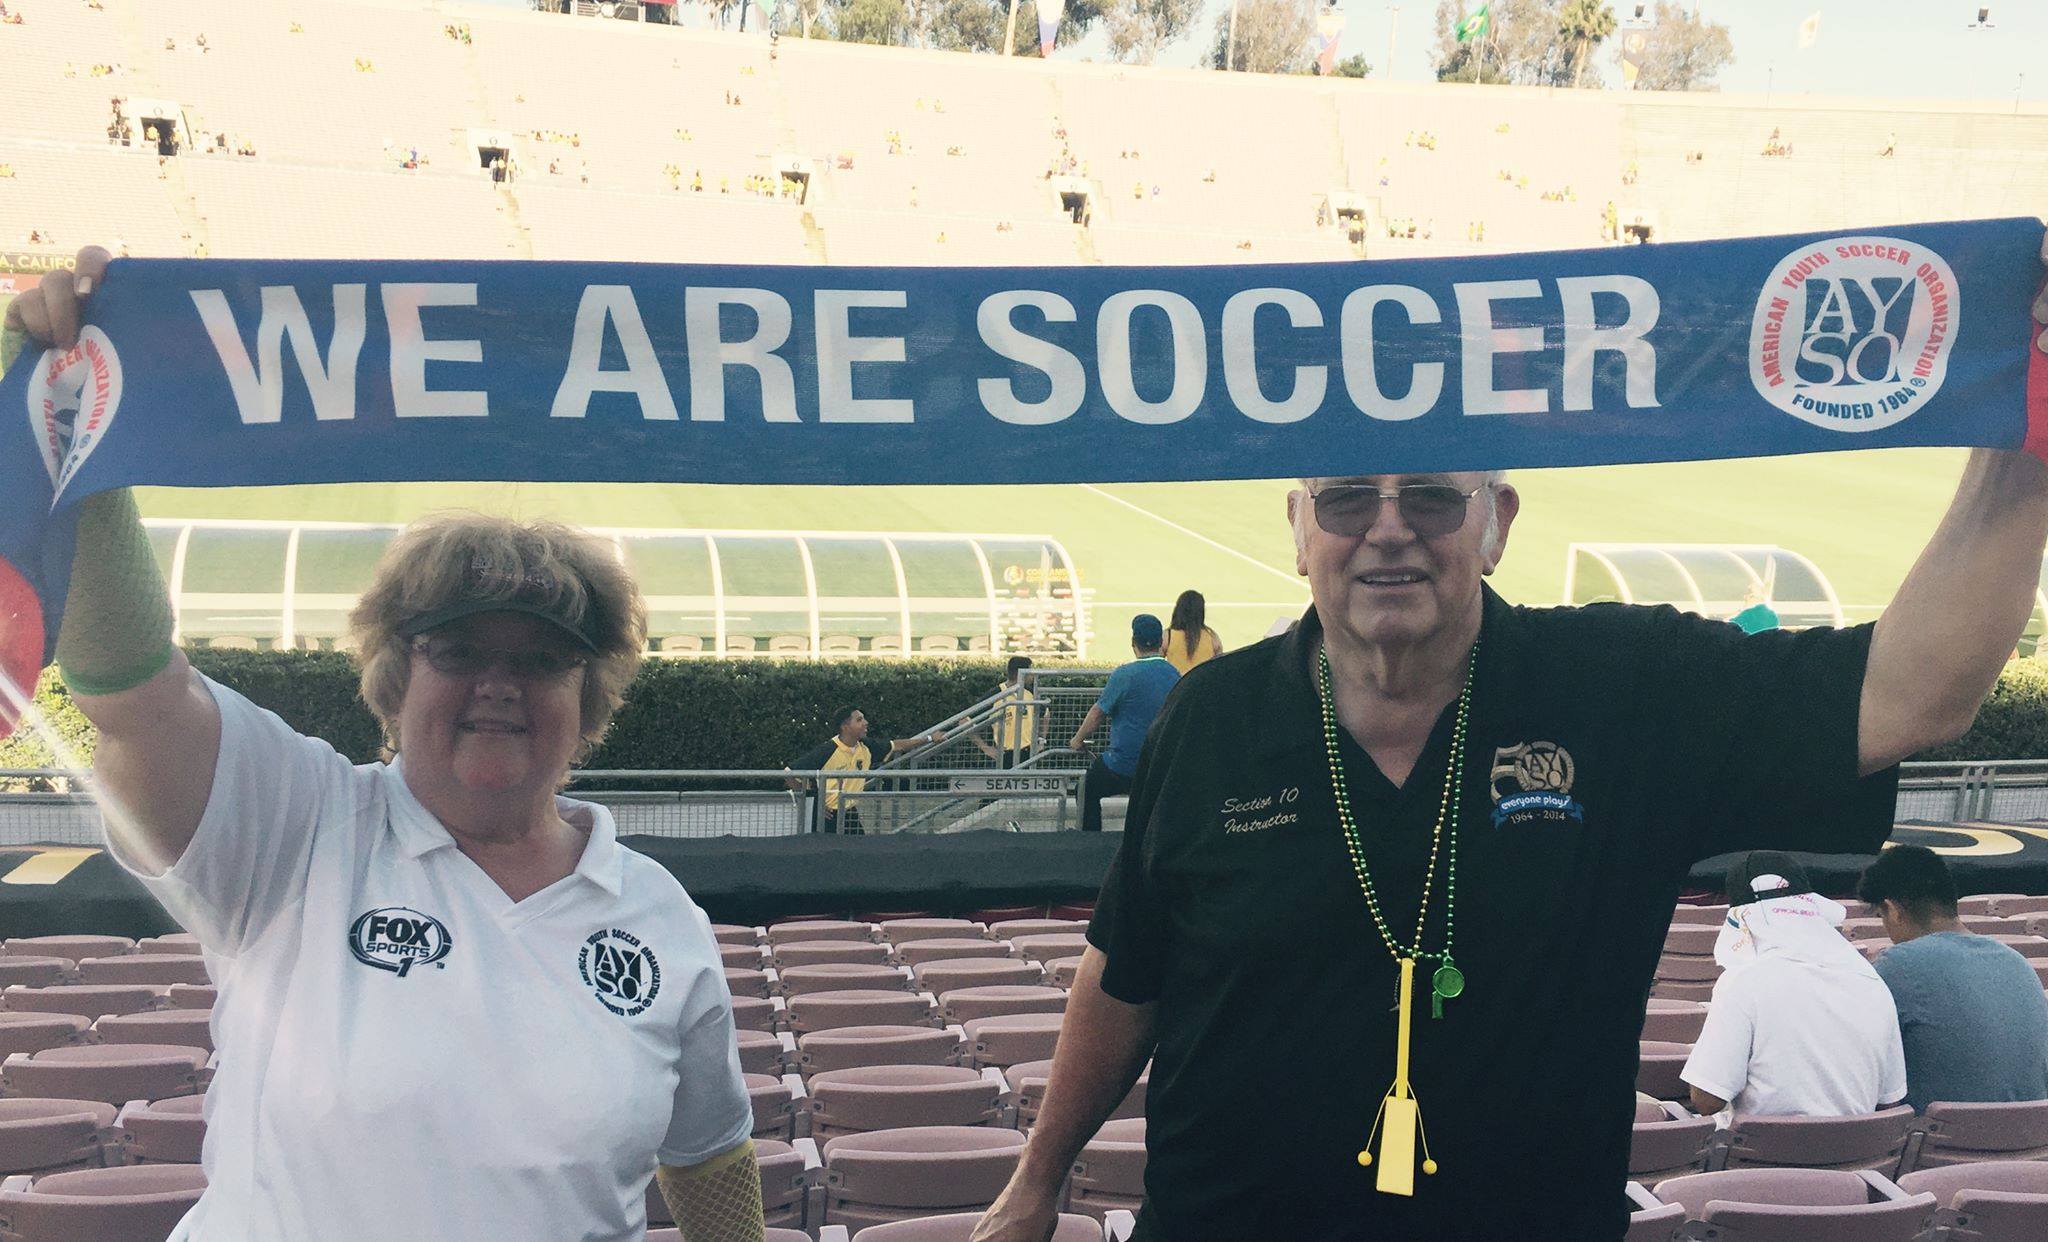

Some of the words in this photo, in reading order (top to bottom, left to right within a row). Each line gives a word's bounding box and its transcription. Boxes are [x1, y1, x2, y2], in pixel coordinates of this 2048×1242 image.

[1762, 297, 1789, 387] AMERICAN
[1782, 252, 1830, 290] YOUTH
[1835, 245, 1911, 265] SOCCER
[1912, 262, 1949, 377] ORGANIZATION
[189, 283, 489, 425] WE
[550, 284, 915, 423] ARE
[976, 274, 1663, 425] SOCCER
[1792, 393, 1874, 420] FOUNDED
[1877, 386, 1918, 414] 1964
[986, 778, 1030, 790] SEATS
[1279, 787, 1299, 803] 10
[1500, 795, 1542, 810] everyone
[1224, 812, 1298, 834] Instructor
[1510, 811, 1534, 824] 1964
[1543, 809, 1566, 821] 2014
[368, 916, 433, 947] FOX
[365, 942, 430, 958] SPORTS
[397, 957, 415, 977] 1
[578, 946, 593, 987] AMERICAN
[586, 929, 608, 946] YOUTH
[611, 928, 641, 948] SOCCER
[640, 946, 661, 1000] ORGANIZATION
